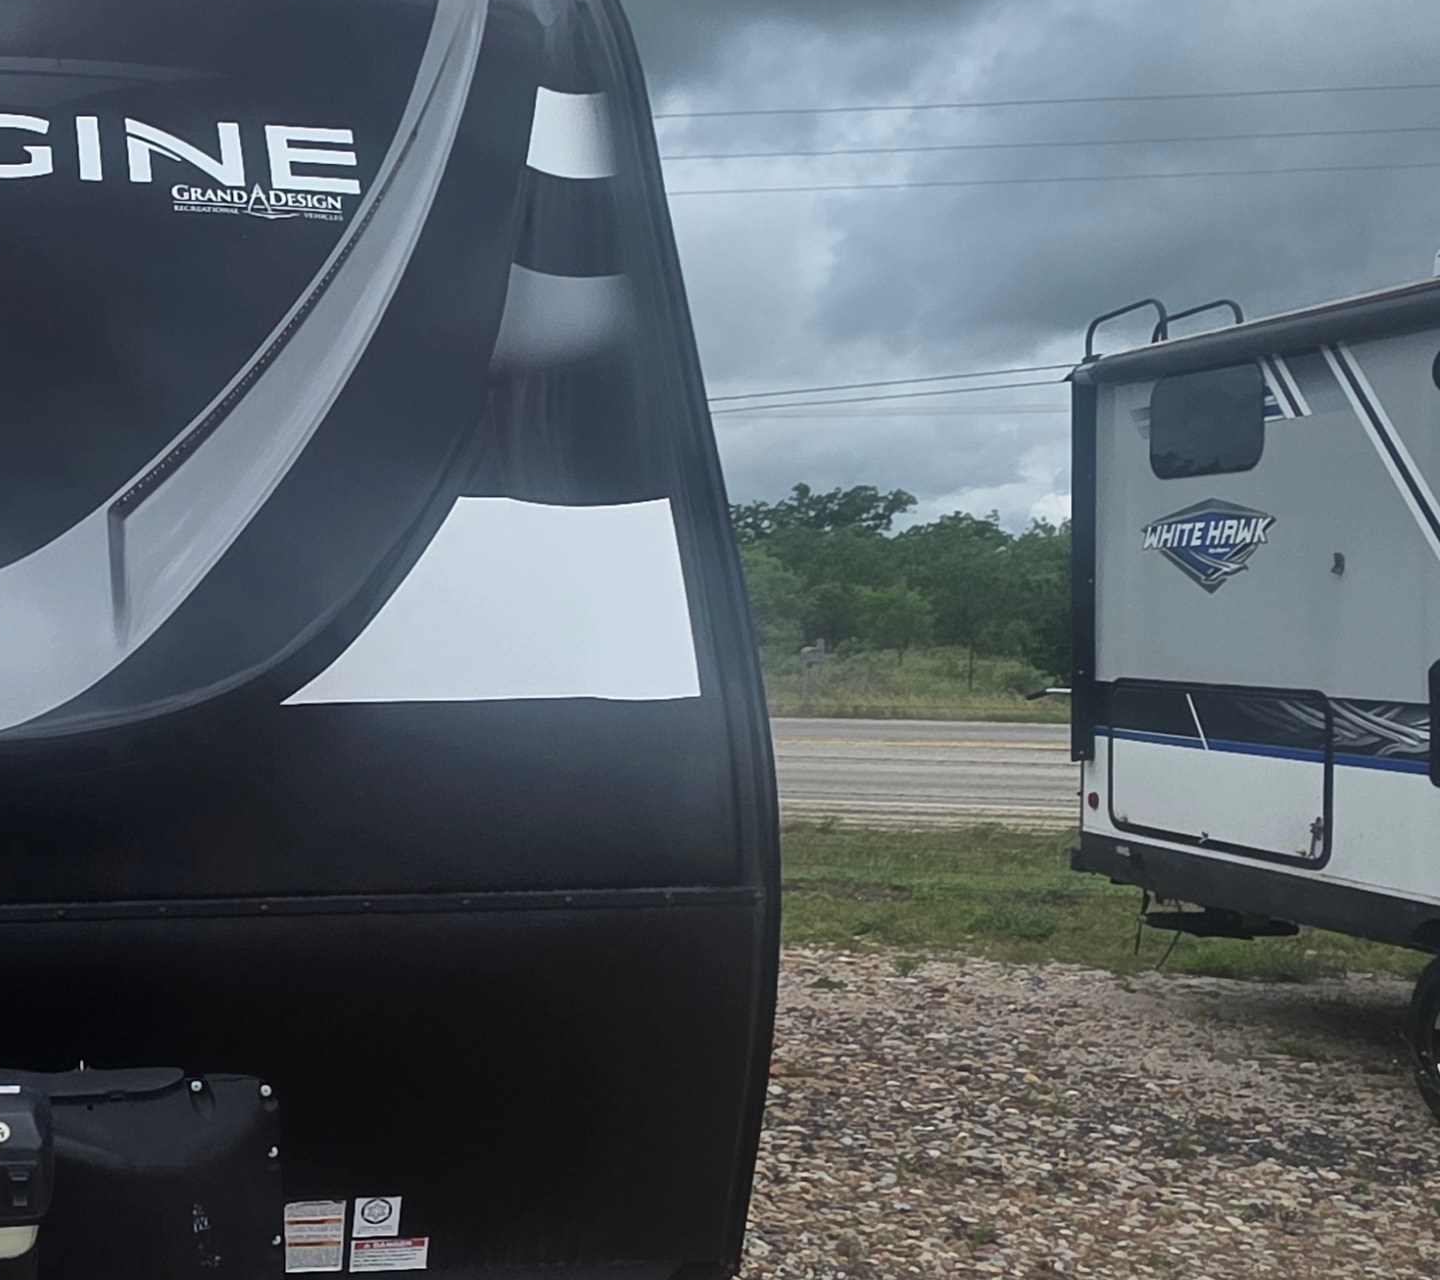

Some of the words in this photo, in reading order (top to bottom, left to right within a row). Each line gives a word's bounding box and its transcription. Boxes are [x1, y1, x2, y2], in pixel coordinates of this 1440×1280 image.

[171, 184, 248, 204] GRAND
[269, 190, 343, 210] DESIGN
[173, 204, 240, 215] RECREATIONAL
[1143, 522, 1206, 549] WHITE
[1205, 517, 1273, 545] HAWK
